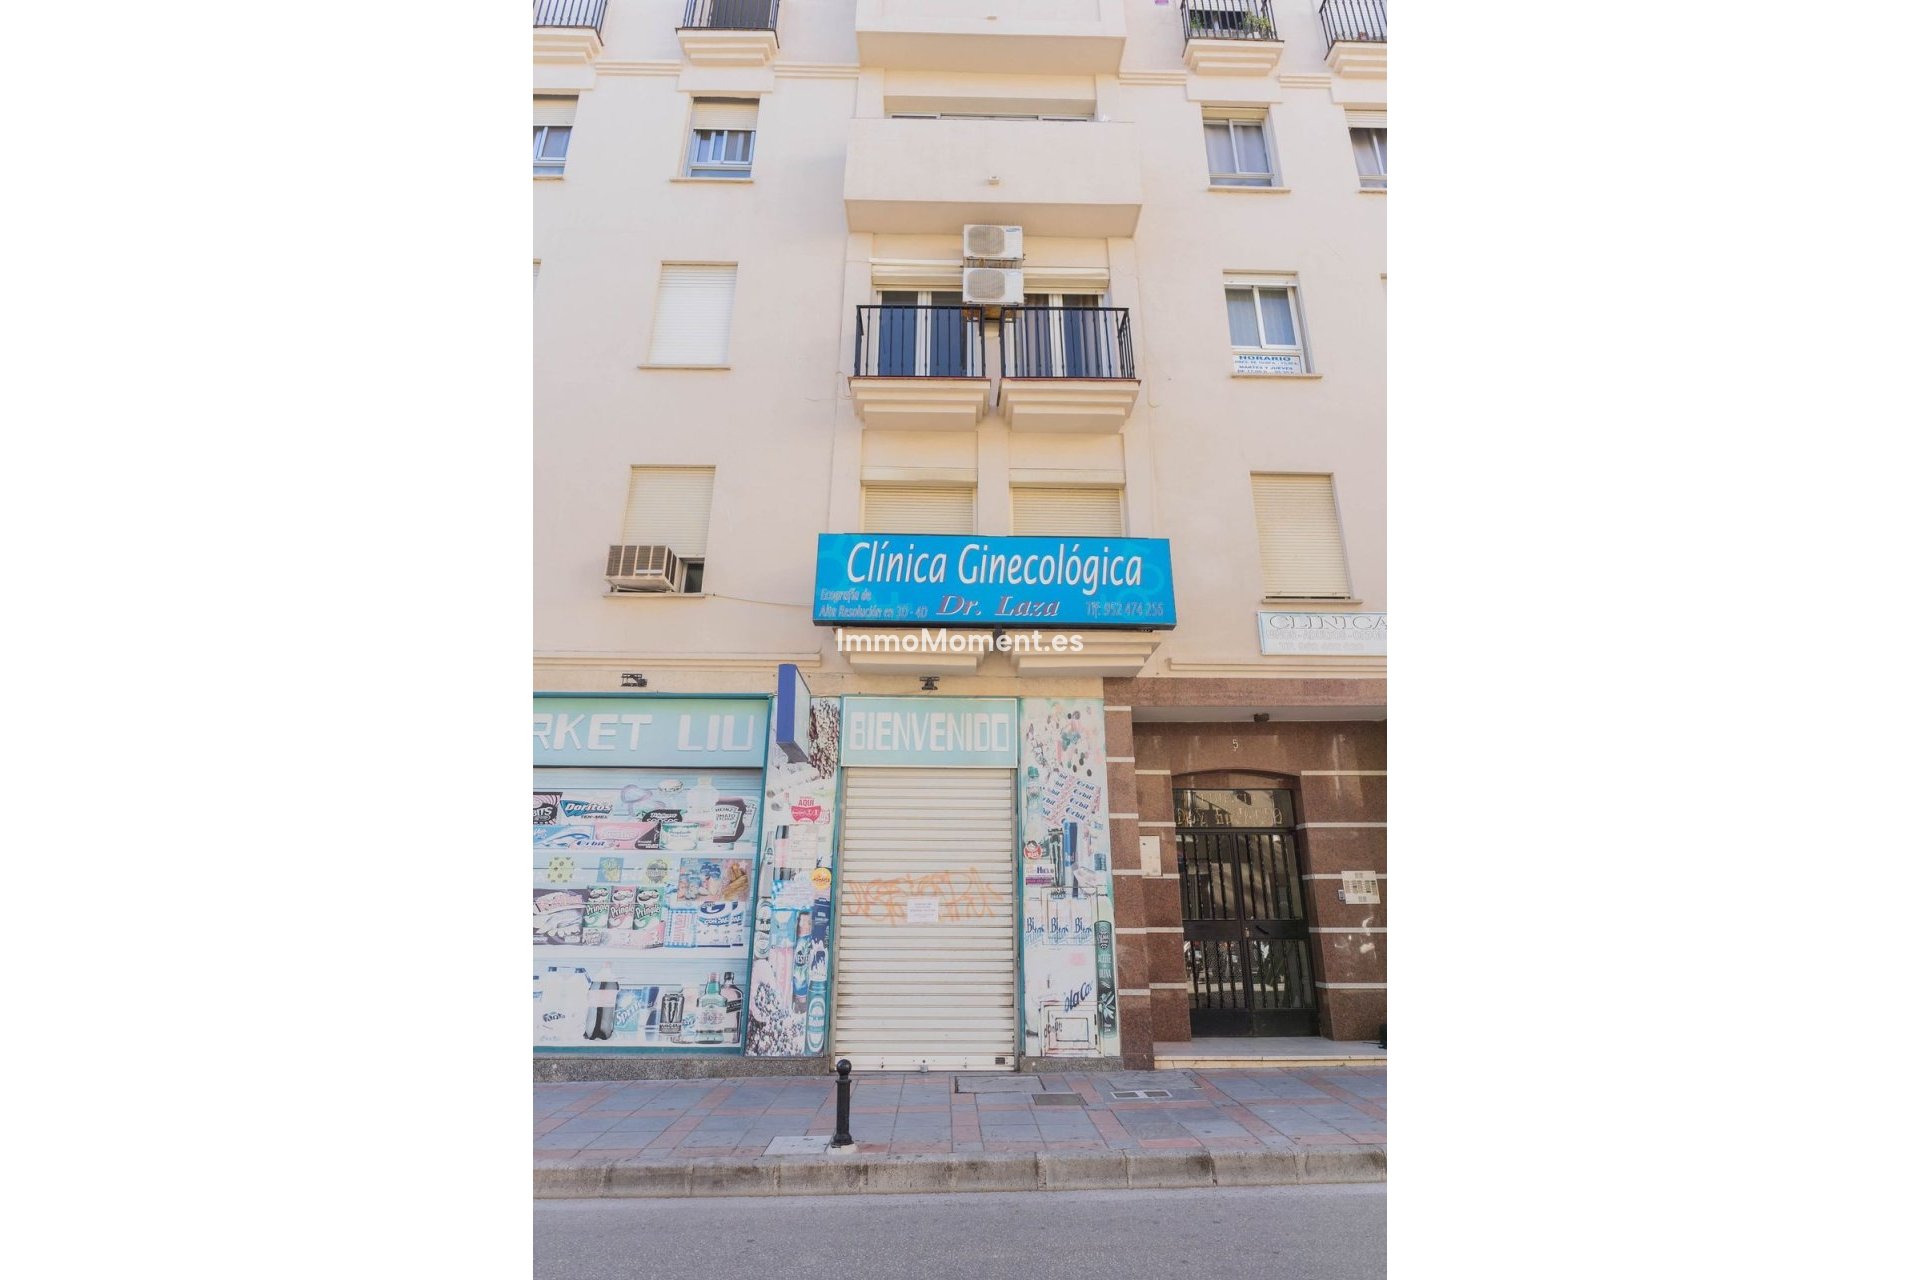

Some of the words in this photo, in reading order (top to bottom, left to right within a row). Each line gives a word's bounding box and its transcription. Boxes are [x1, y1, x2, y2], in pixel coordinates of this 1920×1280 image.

[848, 540, 946, 584] Clínica
[958, 543, 1142, 595] Ginecológica
[936, 594, 982, 616] Dr.
[994, 595, 1061, 617] Laza
[1270, 615, 1387, 631] CLINICA
[677, 714, 754, 751] LIU
[850, 711, 1009, 751] BIENVENIDO
[565, 803, 613, 811] Doritos
